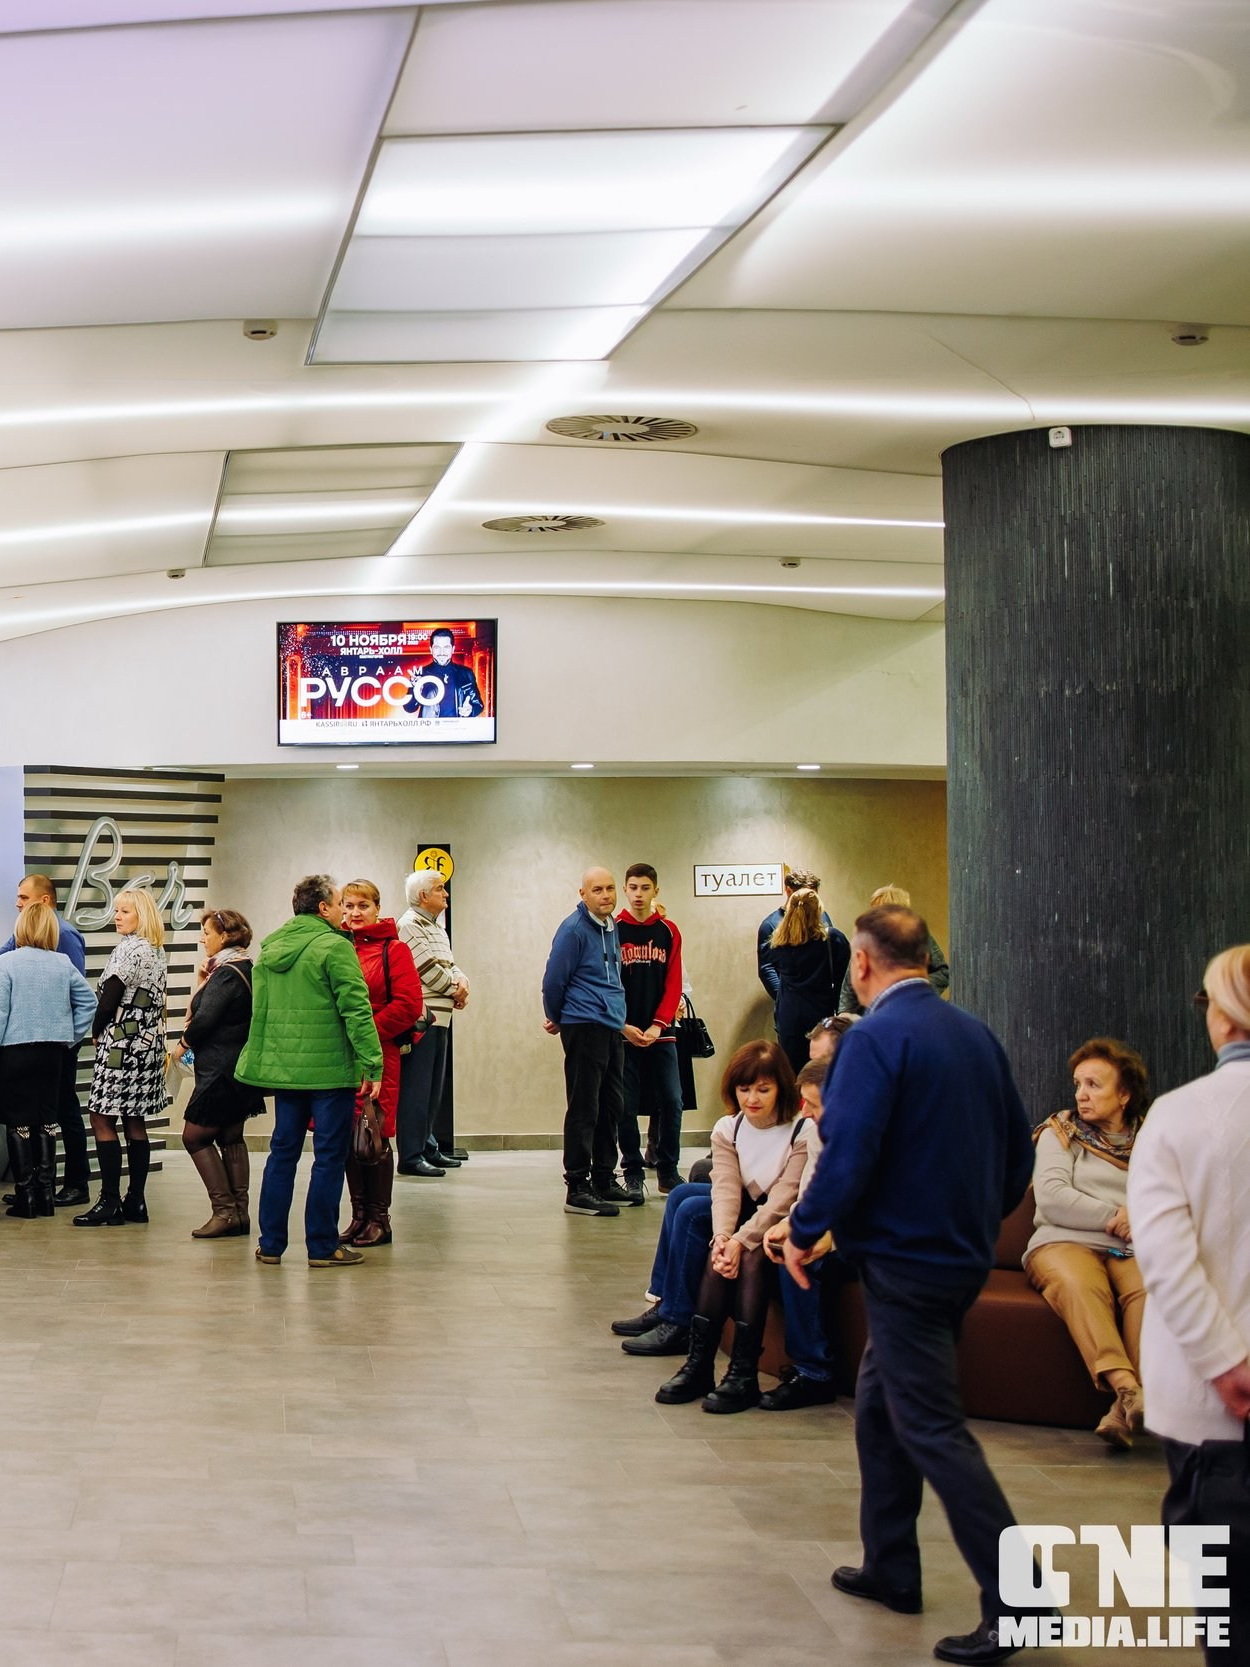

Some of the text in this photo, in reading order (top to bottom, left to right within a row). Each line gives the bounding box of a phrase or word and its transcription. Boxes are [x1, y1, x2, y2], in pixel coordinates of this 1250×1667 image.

[330, 634, 346, 646] 10
[349, 634, 407, 646] НОЯБРЯ
[340, 647, 403, 656] ЯНТАРЬ-ХОЛЛ
[321, 665, 424, 677] АВРААМ
[300, 675, 446, 707] РУССО
[700, 872, 777, 892] туалет
